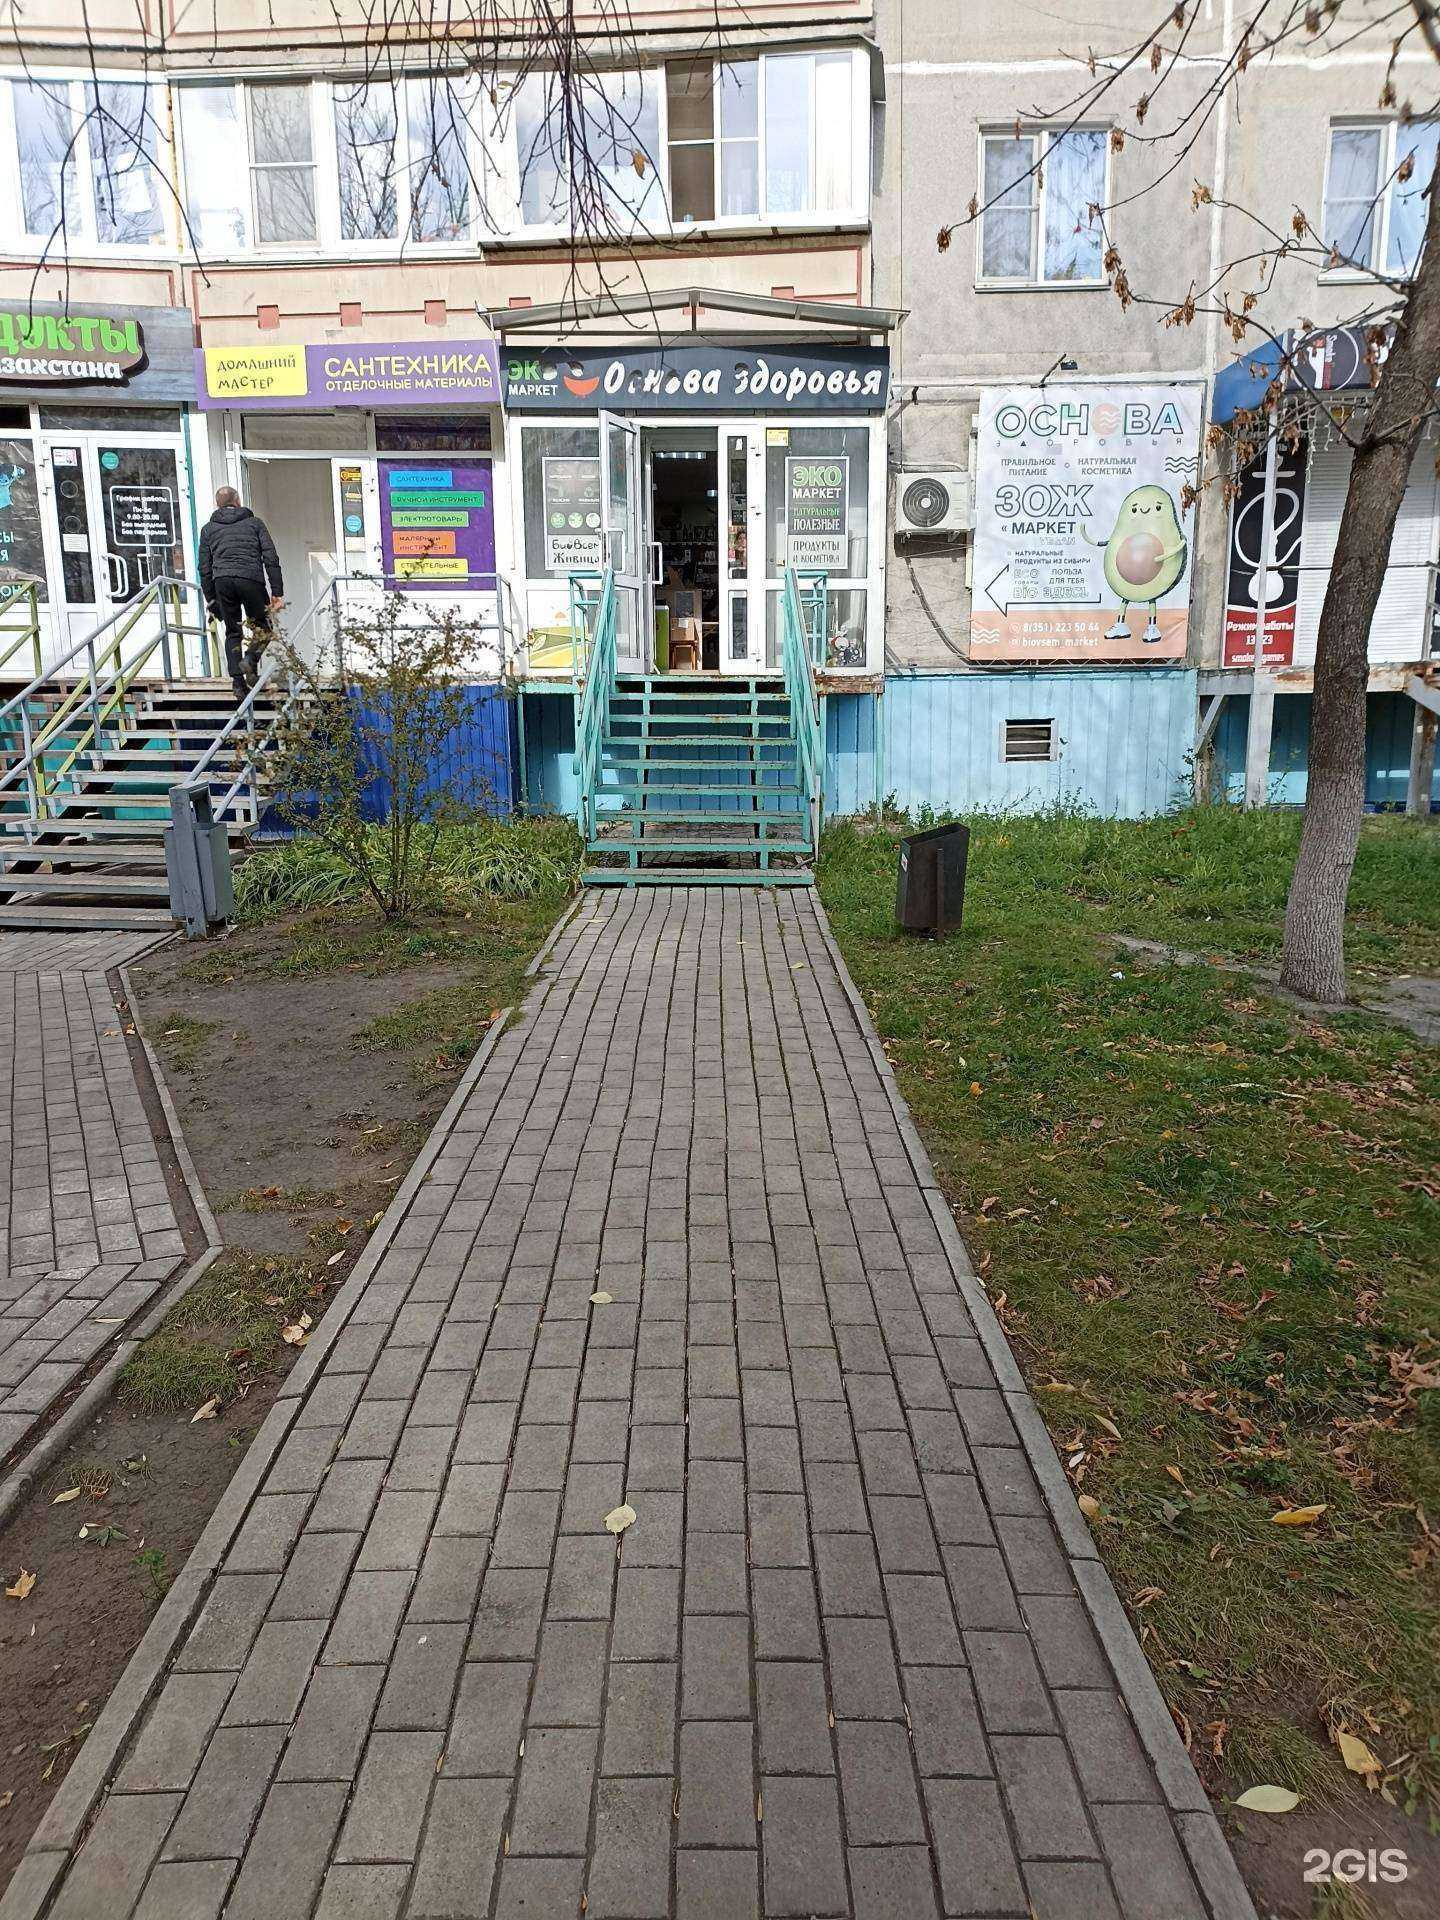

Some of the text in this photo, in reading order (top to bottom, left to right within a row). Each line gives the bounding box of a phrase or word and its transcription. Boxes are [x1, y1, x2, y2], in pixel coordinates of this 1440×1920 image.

[0, 357, 122, 379] захстана
[217, 354, 296, 372] ДОМАШНИЙ
[324, 353, 492, 378] САНТЕХНИКА
[217, 376, 274, 390] МАСТЕР
[326, 376, 493, 392] ОТДЕЛОЧНЫЕ МАТЕРИАЛЫ
[508, 384, 558, 396] МАРКЕТ
[1001, 458, 1056, 467] ПРАВИЛЬНОЕ
[1078, 457, 1137, 466] НАТУРАЛЬНАЯ
[792, 465, 843, 487] ЭКО
[1008, 468, 1047, 476] ПИТАНИЕ
[1081, 467, 1132, 475] КОСМЕТИКА
[792, 488, 842, 498] МАРКЕТ
[995, 484, 1094, 518] ЗОЖ
[793, 518, 841, 531] ПОЛЕЗНЫЕ
[1011, 521, 1076, 534] МАРКЕТ
[793, 541, 840, 551] ПРОДУКТЫ
[1263, 620, 1294, 631] аботы
